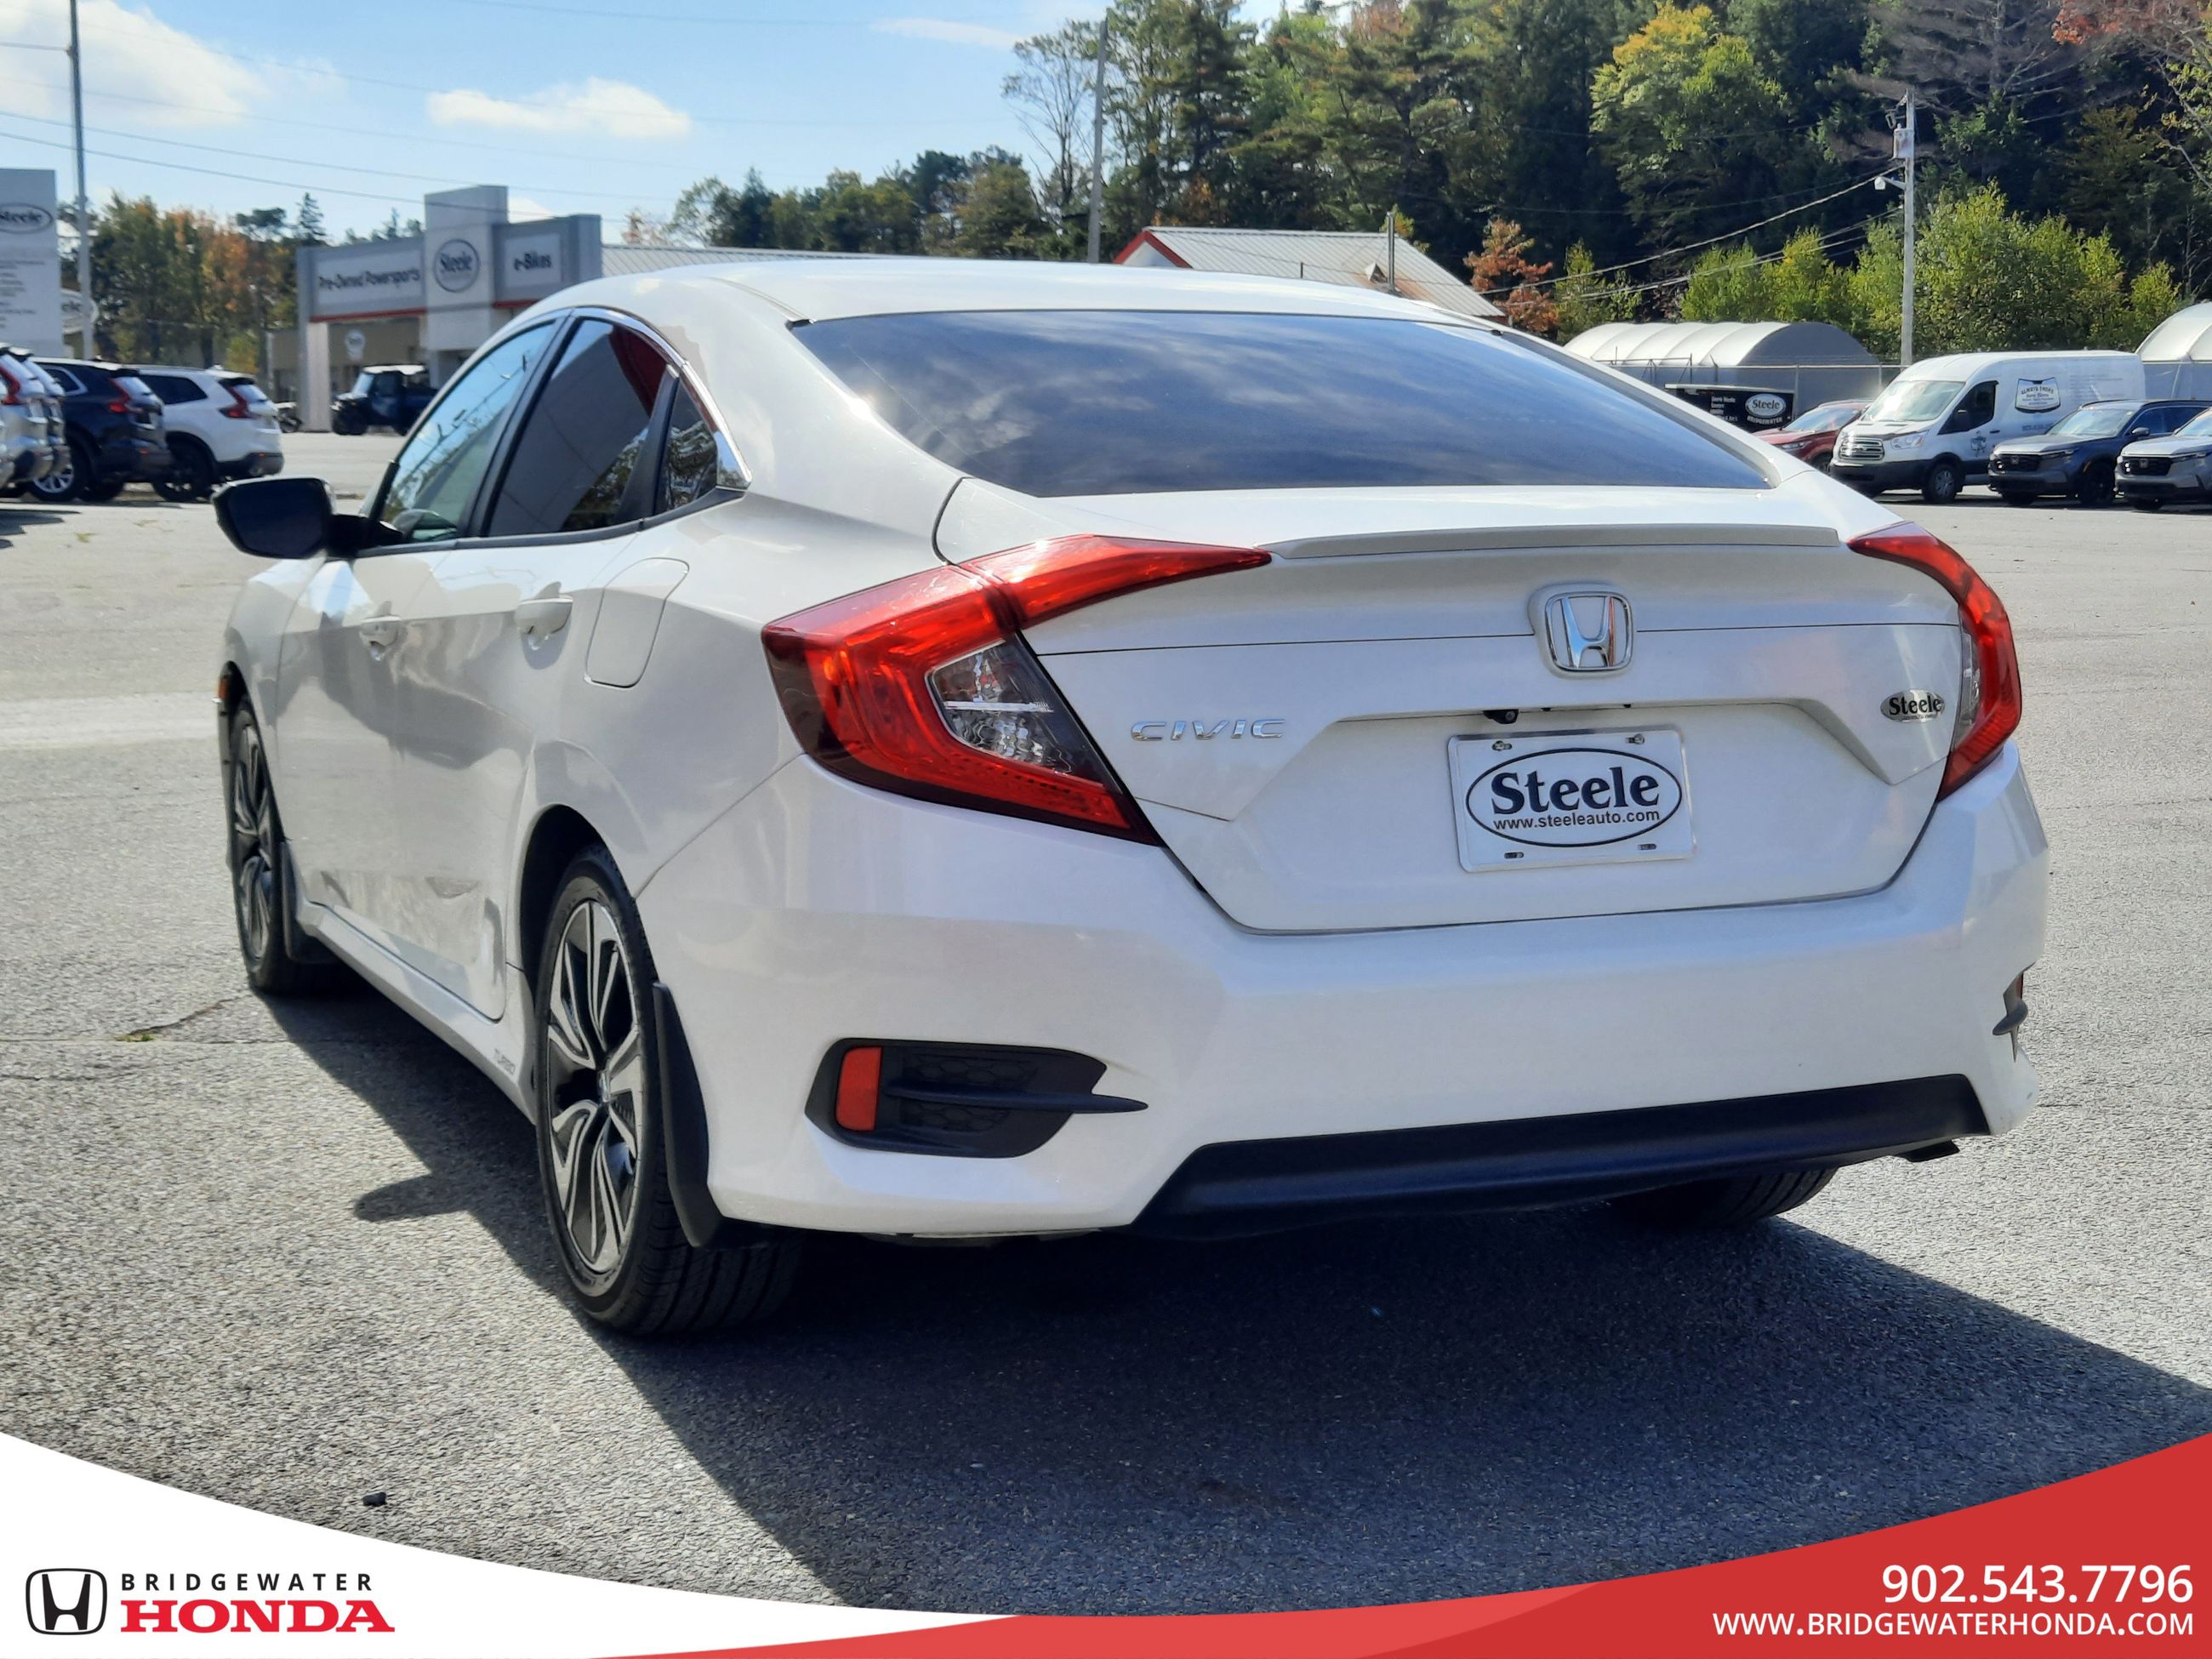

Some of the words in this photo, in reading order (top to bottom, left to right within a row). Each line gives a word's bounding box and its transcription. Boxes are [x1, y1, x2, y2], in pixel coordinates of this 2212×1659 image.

[1753, 399, 1781, 410] Steele
[1889, 694, 1942, 715] Steele
[1130, 719, 1286, 741] CIVIC
[1491, 766, 1660, 815] Steele
[1493, 810, 1660, 830] www.steeleauto.com
